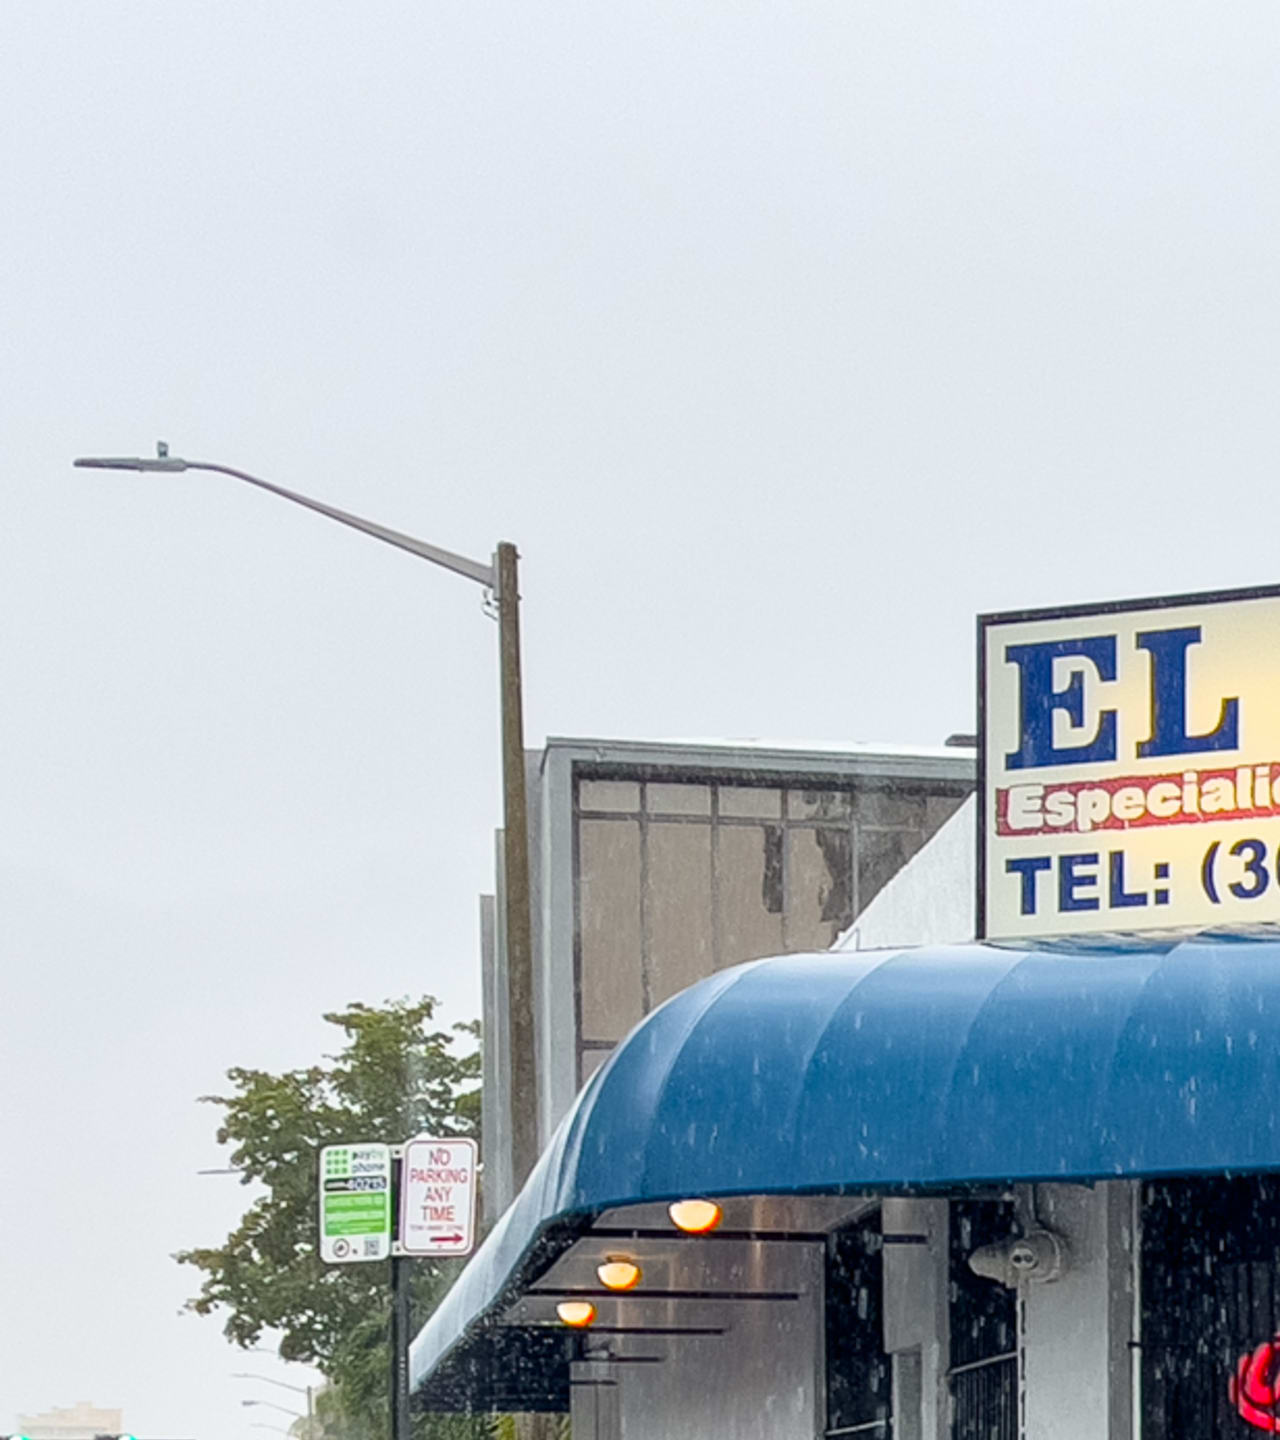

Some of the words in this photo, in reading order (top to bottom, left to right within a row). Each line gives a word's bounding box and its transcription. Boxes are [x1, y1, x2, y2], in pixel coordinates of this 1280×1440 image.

[1005, 624, 1240, 771] EL
[1006, 851, 1170, 917] TEL:
[429, 1148, 452, 1166] NO
[409, 1167, 468, 1184] PARKING
[424, 1186, 453, 1203] ANY
[420, 1205, 456, 1222] TIME
